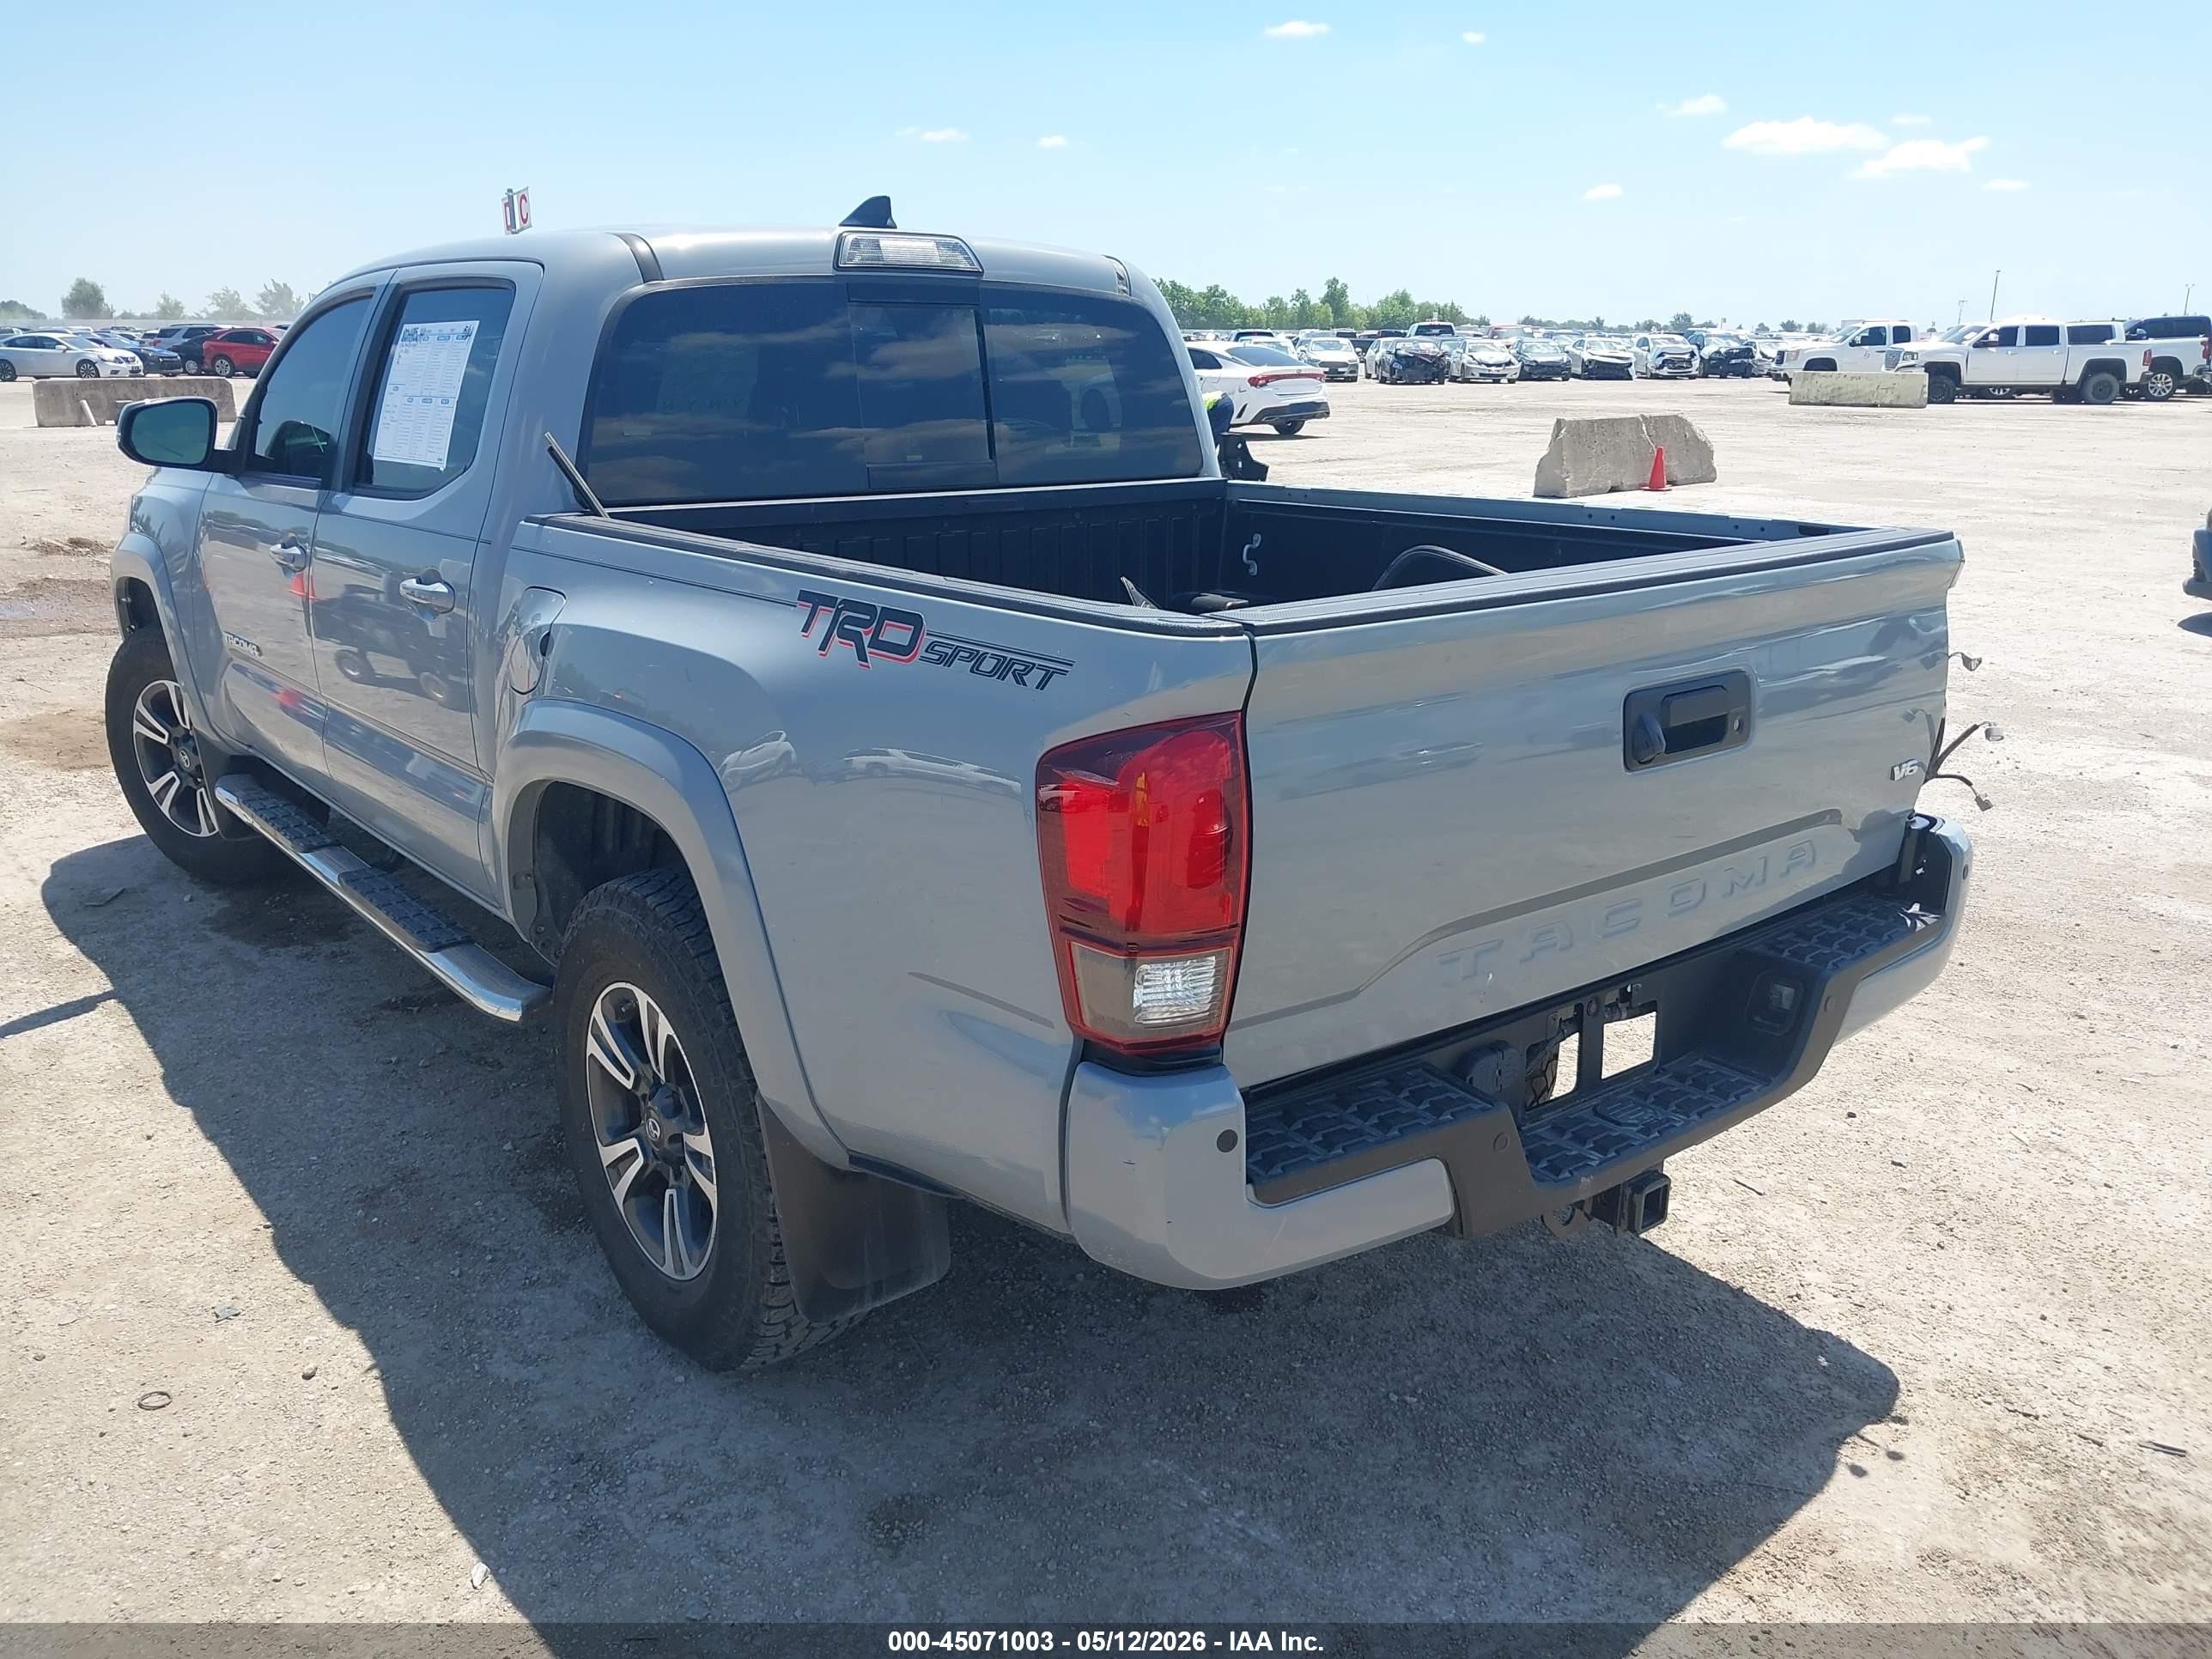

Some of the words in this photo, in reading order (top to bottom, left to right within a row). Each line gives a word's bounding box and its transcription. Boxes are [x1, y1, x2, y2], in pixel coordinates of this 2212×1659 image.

[519, 193, 529, 225] C
[797, 589, 927, 670] TRD
[918, 639, 1073, 692] SPORT
[1891, 758, 1920, 781] V6
[1436, 838, 1818, 982] TACOMA
